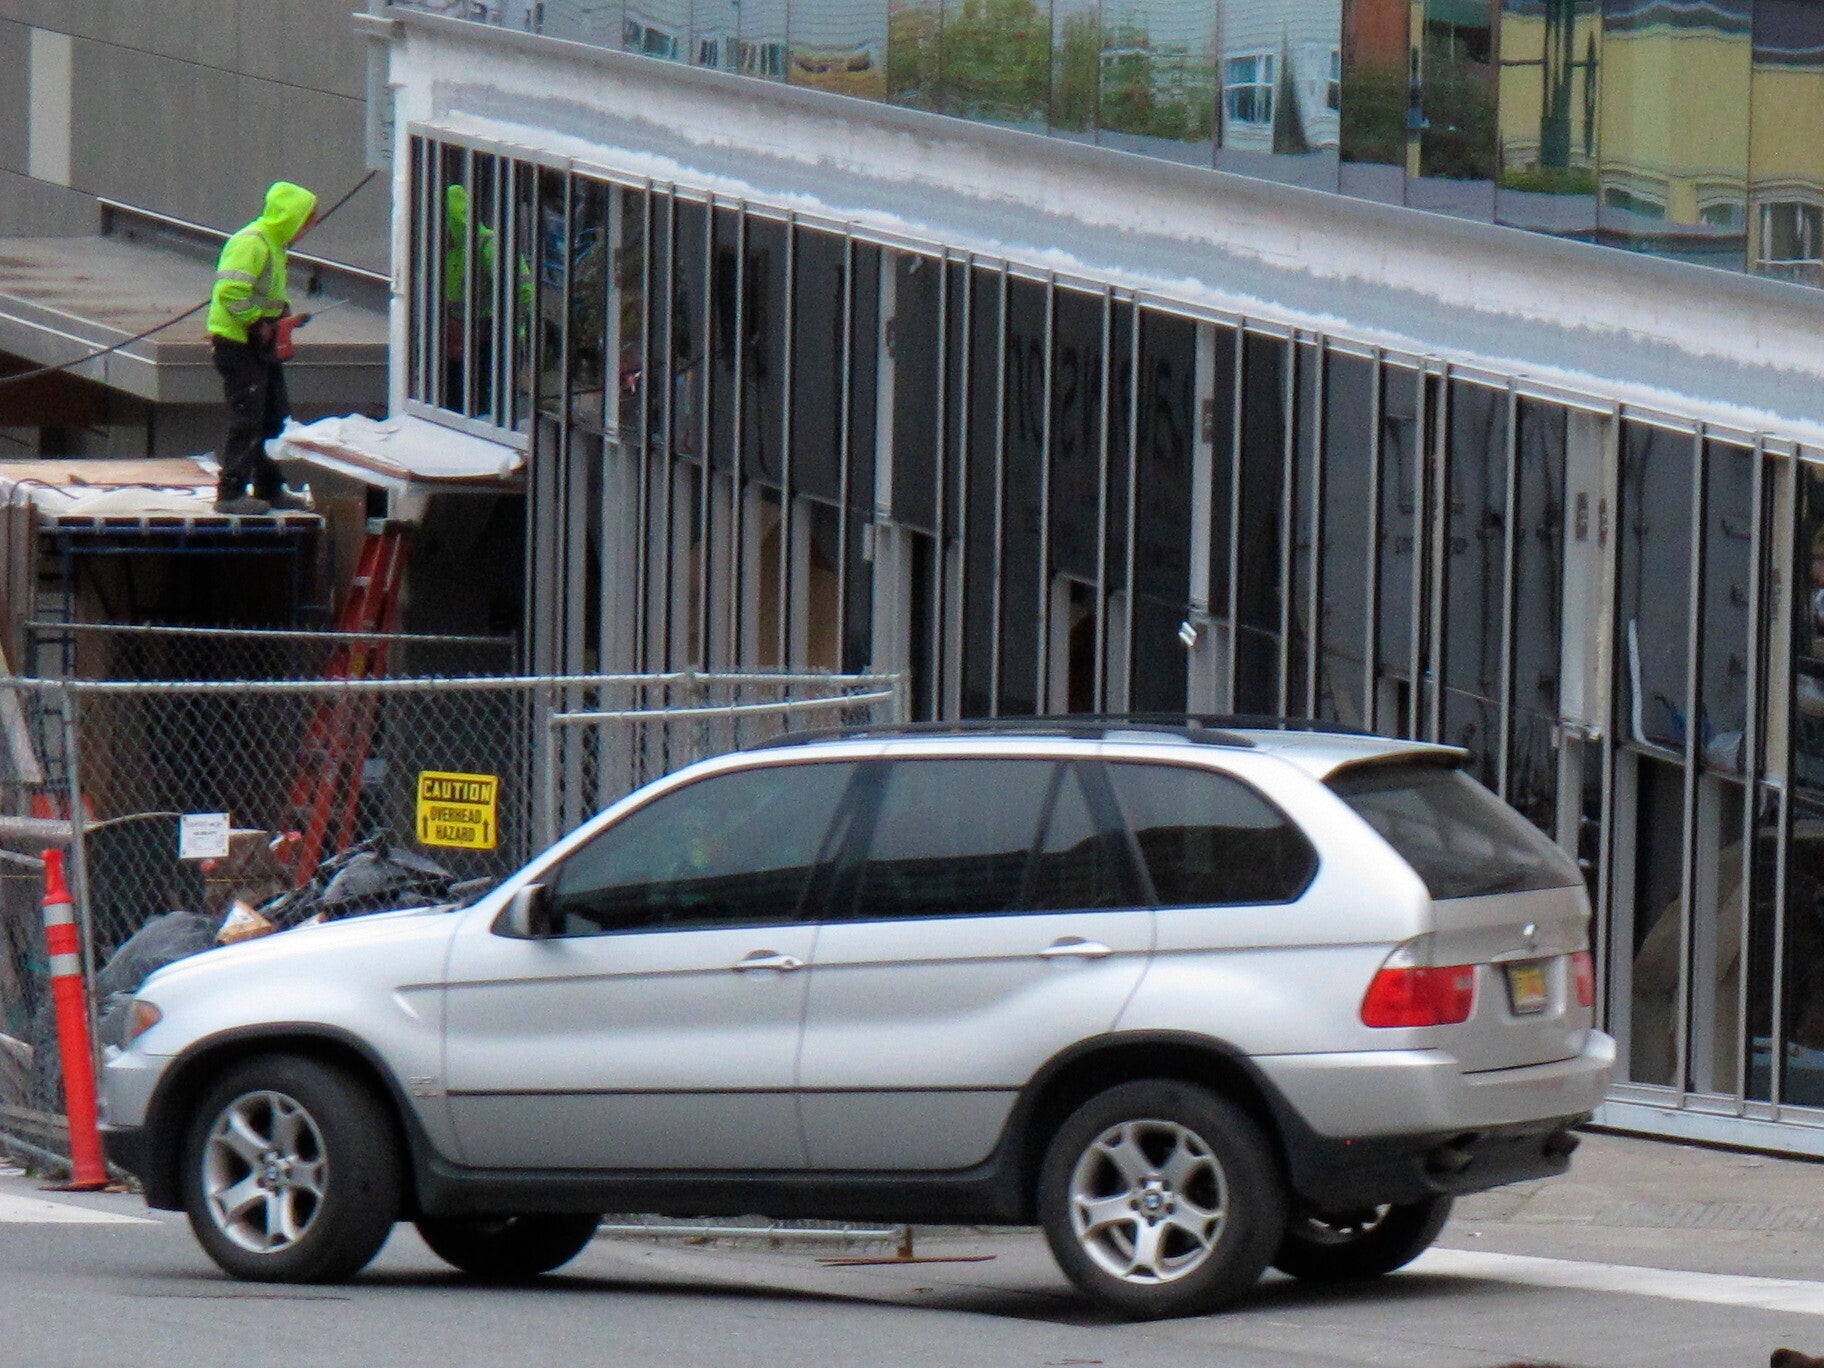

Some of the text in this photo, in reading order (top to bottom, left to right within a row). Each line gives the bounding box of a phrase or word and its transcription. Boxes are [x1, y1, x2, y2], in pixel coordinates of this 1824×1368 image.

[423, 779, 492, 802] CAUTION
[429, 805, 483, 824] OVERHEAD
[435, 824, 476, 842] HAZARD
